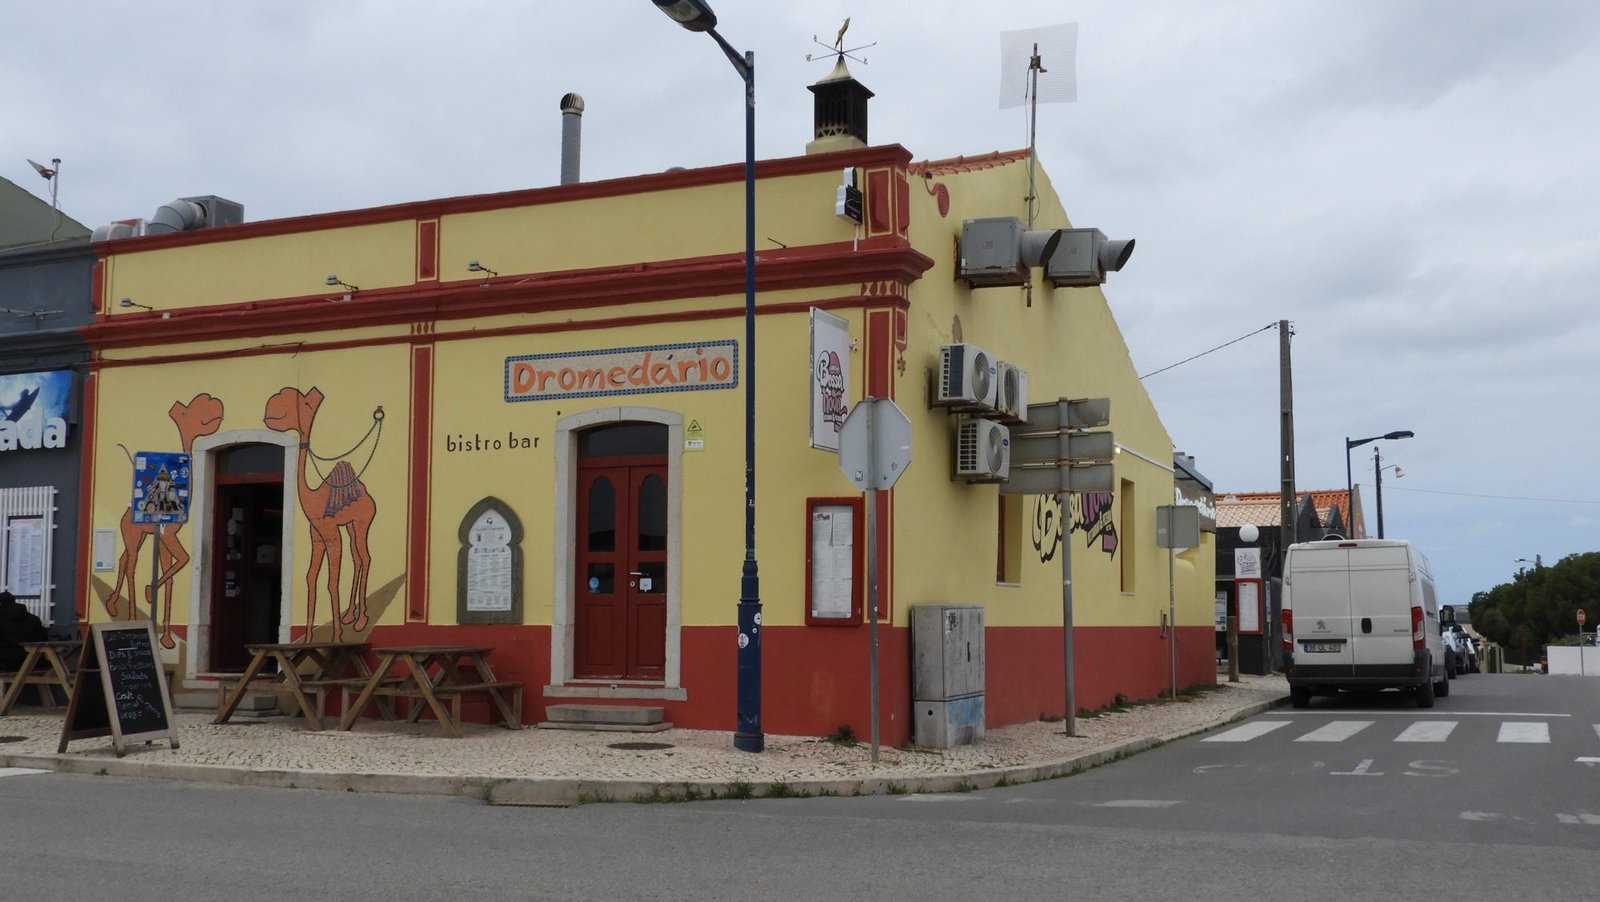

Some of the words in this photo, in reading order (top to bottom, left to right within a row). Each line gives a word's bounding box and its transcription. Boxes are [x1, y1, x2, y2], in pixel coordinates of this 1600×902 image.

[512, 348, 731, 394] Dromedário
[447, 434, 502, 452] bistro
[509, 432, 540, 450] bar
